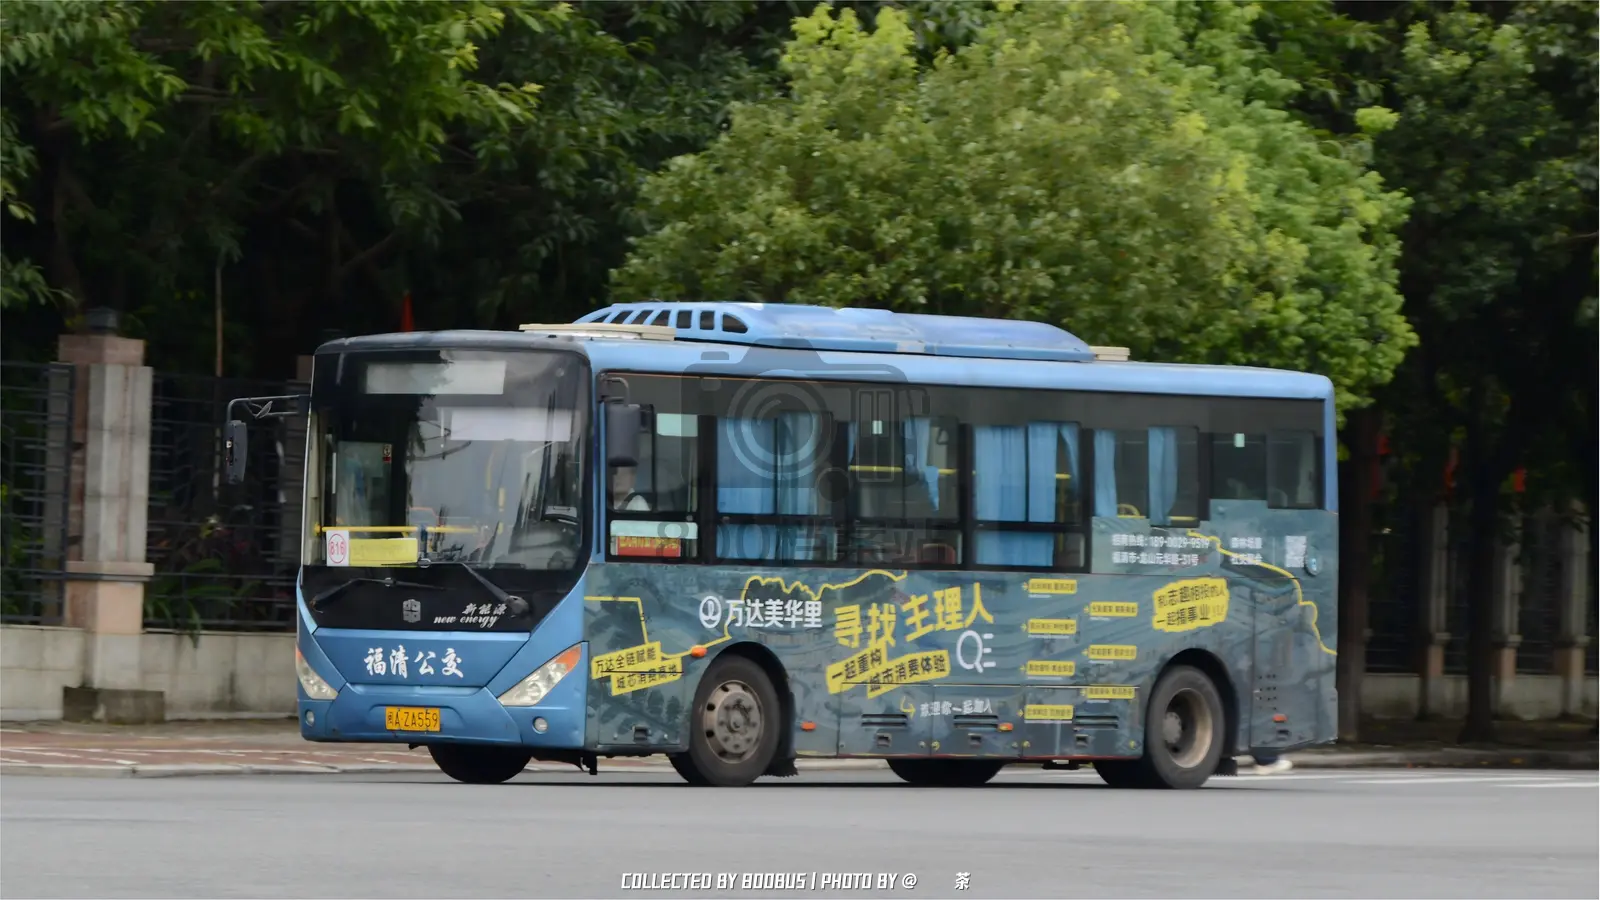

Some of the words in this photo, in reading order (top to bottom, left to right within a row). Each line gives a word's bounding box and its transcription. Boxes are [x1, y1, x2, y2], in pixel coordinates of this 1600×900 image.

[329, 541, 345, 556] 816
[433, 616, 456, 624] new
[460, 616, 500, 628] energy
[462, 603, 507, 615] 新能源
[725, 598, 822, 628] 万达美华里
[833, 582, 994, 650] 寻找主理人
[364, 644, 464, 678] 福清公交
[595, 645, 657, 677] 万达全链赋能
[831, 648, 883, 681] 一起重构
[868, 653, 946, 692] 城市消费体验
